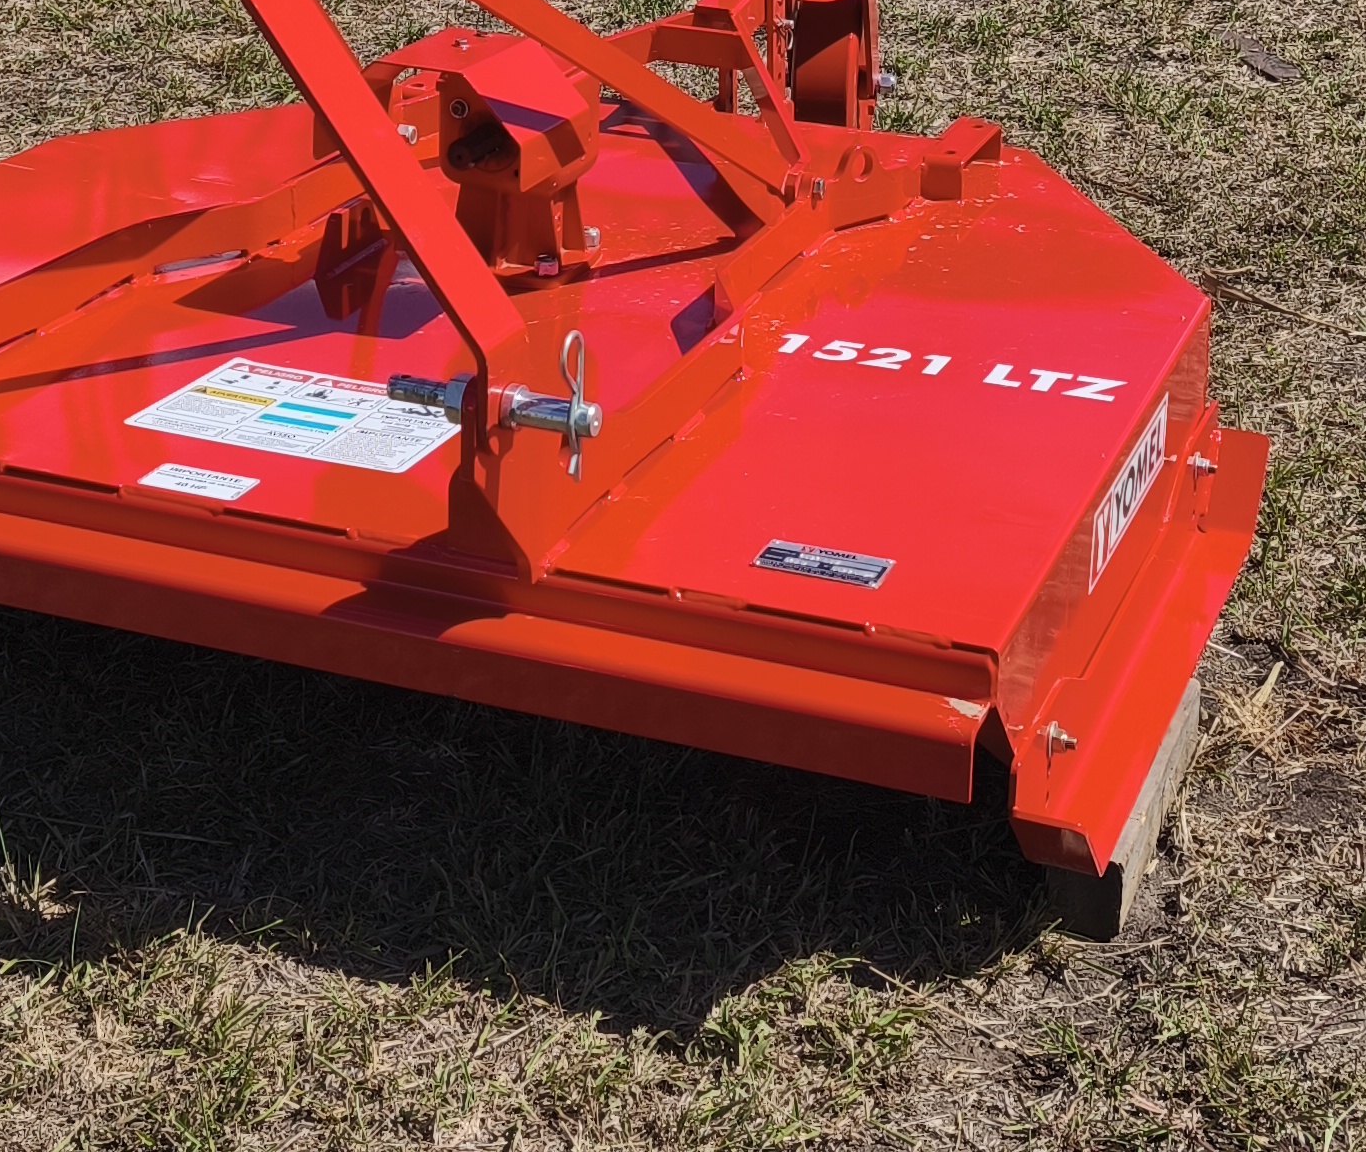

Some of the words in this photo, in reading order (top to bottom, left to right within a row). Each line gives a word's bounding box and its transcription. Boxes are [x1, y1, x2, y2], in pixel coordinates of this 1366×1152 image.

[252, 367, 304, 381] PELIGRO
[777, 333, 952, 375] 1521
[982, 363, 1128, 402] LTZ
[380, 414, 444, 427] IMPORTANTE
[169, 467, 243, 483] IMPORTANTE
[1114, 417, 1163, 536] YOMEL
[819, 548, 858, 560] YOMEL
